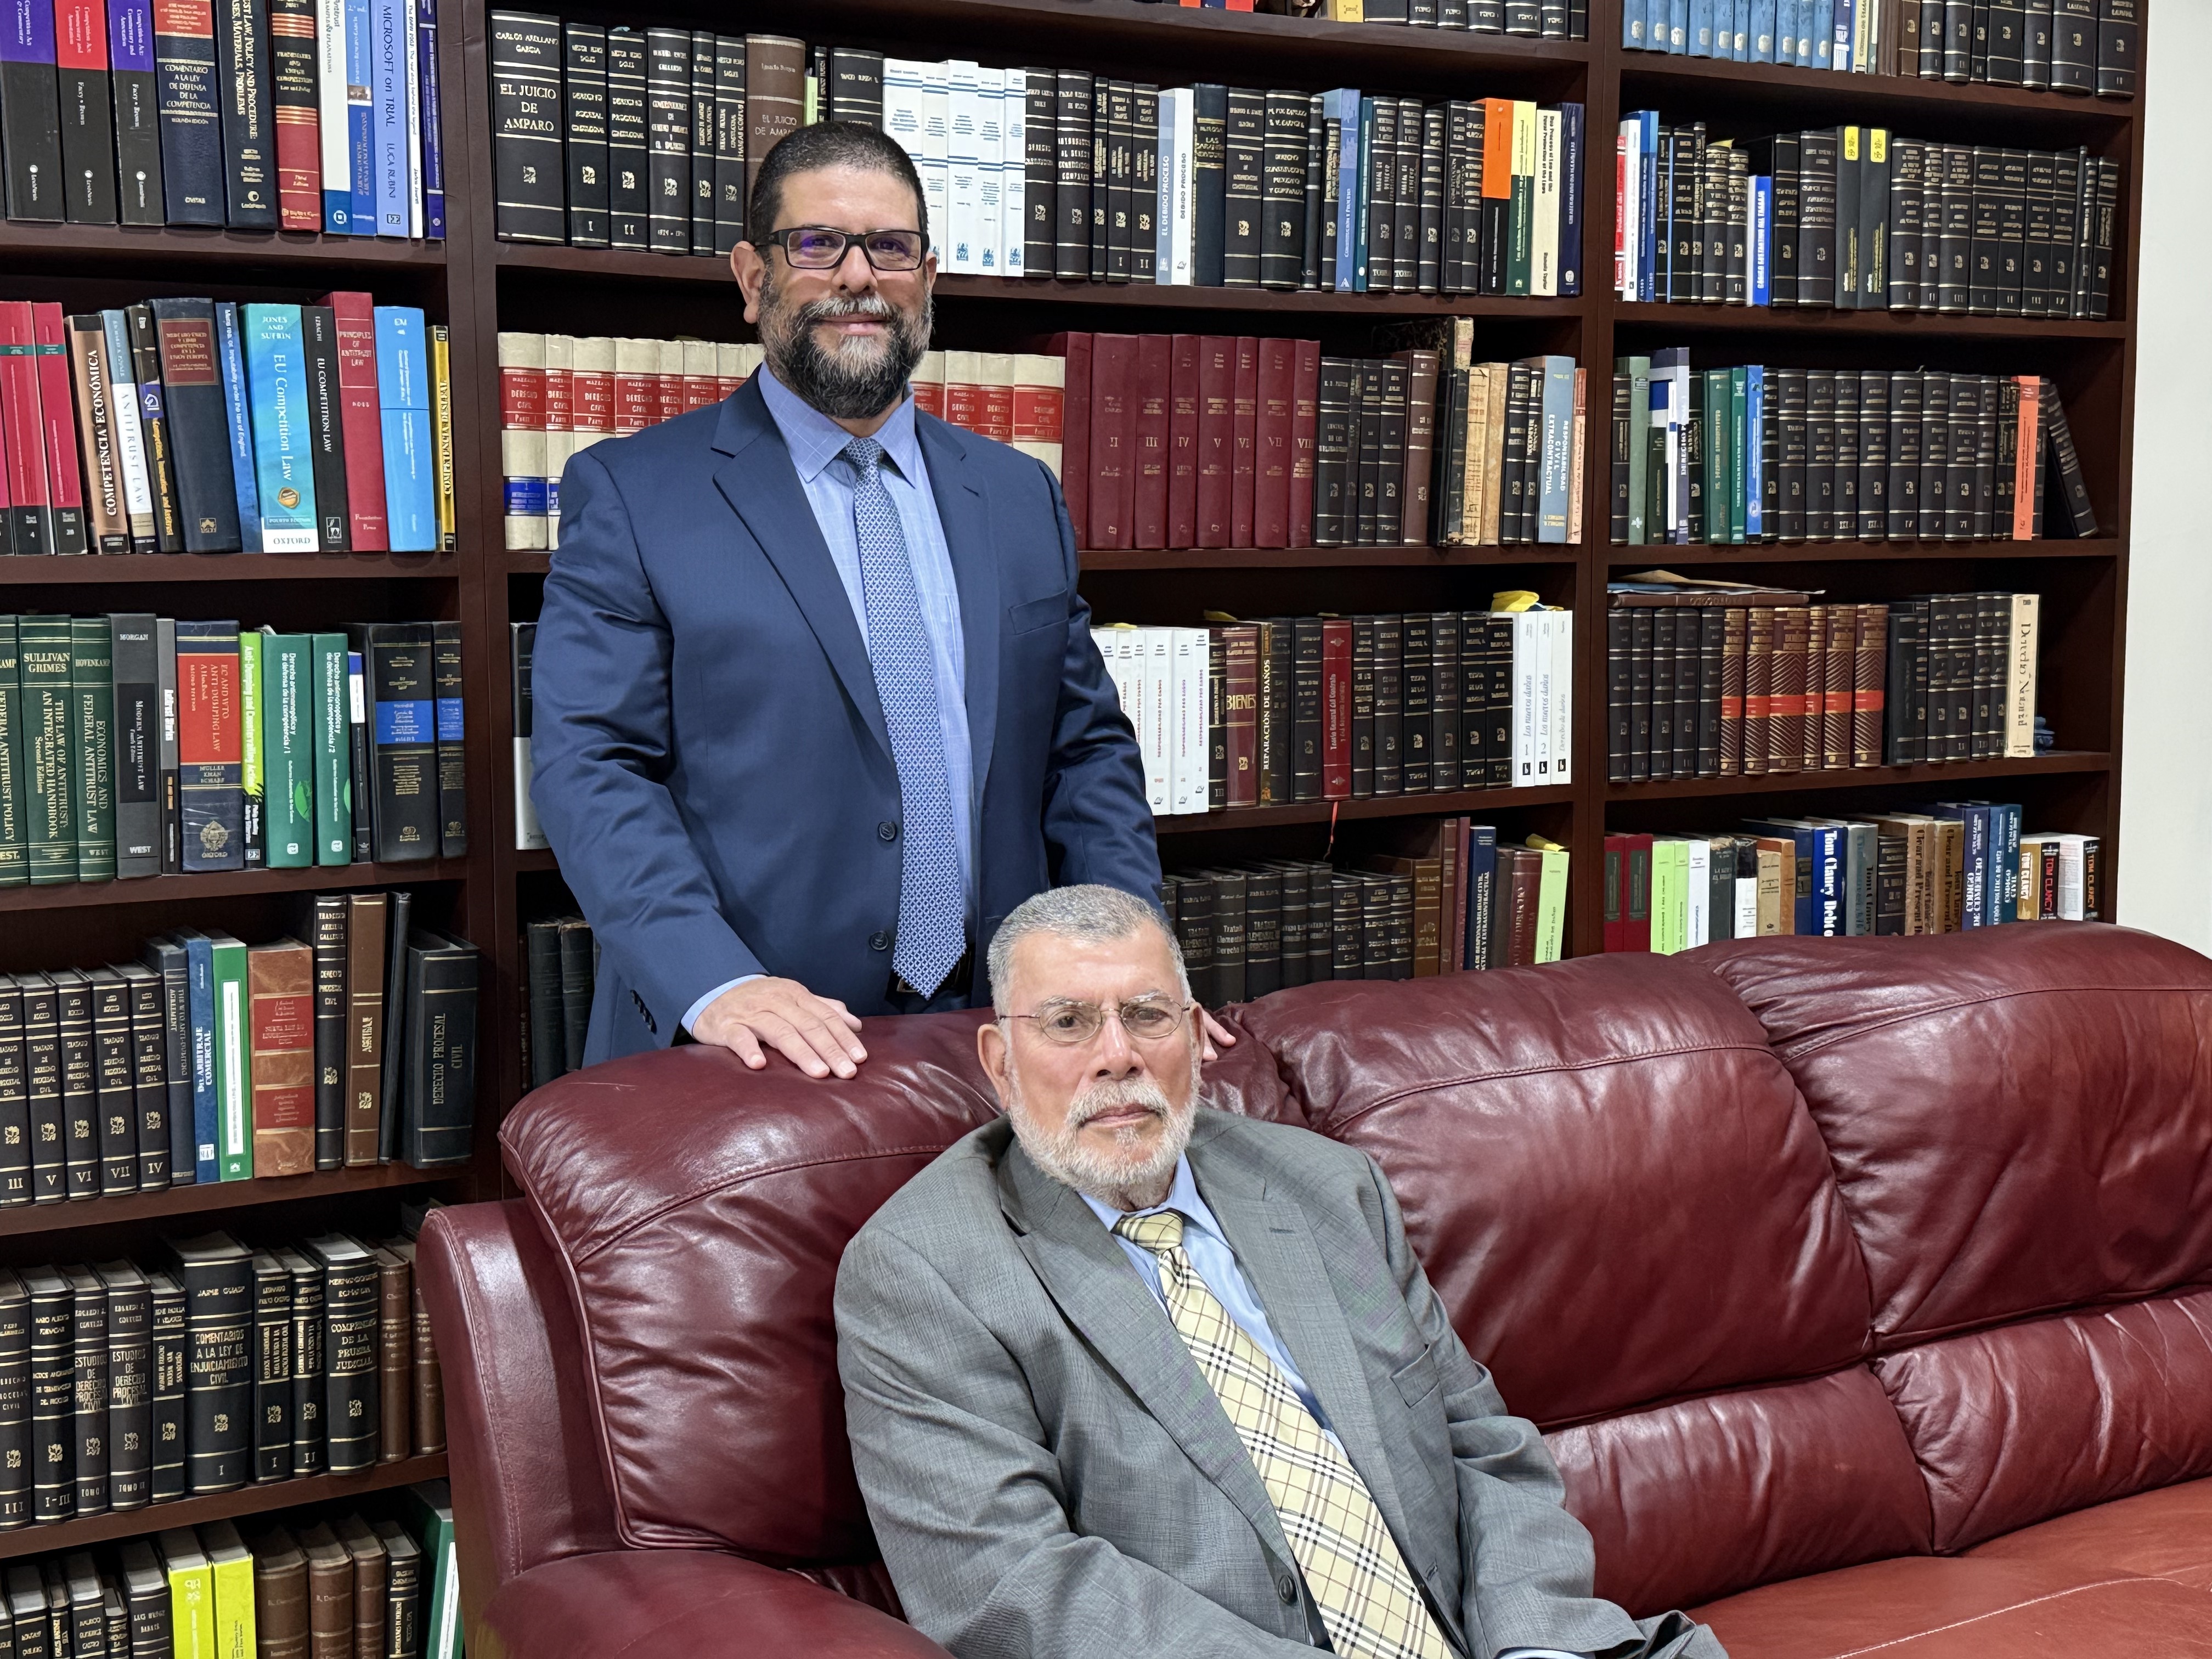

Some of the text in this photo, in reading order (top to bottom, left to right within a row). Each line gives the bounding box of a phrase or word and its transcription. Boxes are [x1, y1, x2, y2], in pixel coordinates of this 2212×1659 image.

[383, 5, 394, 75] MICROSOFT
[500, 84, 556, 99] EL JUICIO
[386, 96, 396, 127] TRIAL
[521, 102, 538, 114] DE
[504, 119, 554, 131] AMPARO
[273, 354, 285, 374] EU
[276, 377, 290, 452] Competition
[24, 653, 70, 663] SULLIVAN
[29, 663, 67, 673] GRIMES
[1263, 696, 1270, 708] DE
[1824, 831, 1838, 855] Tom
[432, 1064, 444, 1104] DERECHO
